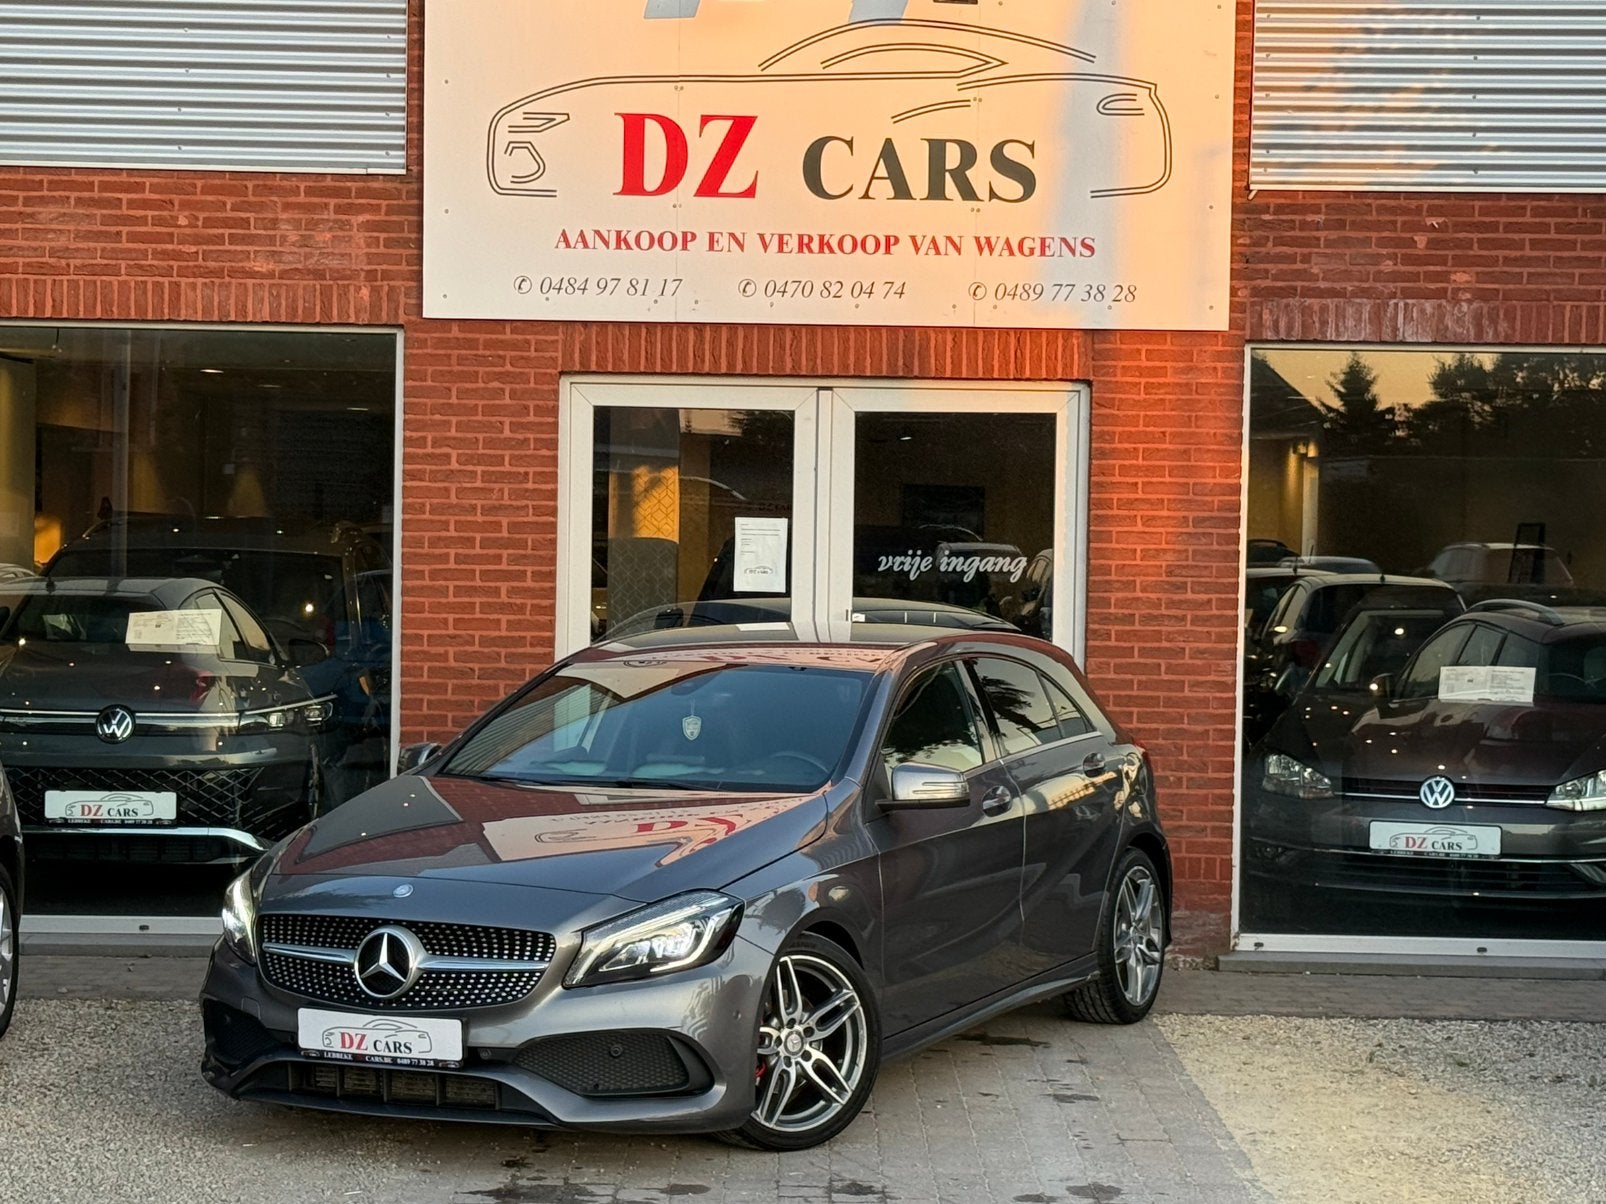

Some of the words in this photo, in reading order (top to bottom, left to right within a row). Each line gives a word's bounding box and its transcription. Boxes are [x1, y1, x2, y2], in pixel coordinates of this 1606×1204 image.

[611, 111, 759, 199] DZ
[801, 134, 1038, 205] CARS
[553, 228, 699, 253] AANKOOP
[706, 230, 747, 254] EN
[755, 232, 901, 256] VERKOOP
[907, 233, 964, 257] VAN
[972, 235, 1097, 259] WAGENS
[538, 276, 590, 296] 0484
[595, 277, 622, 297] 97
[625, 277, 651, 298] 81
[657, 278, 684, 298] 17
[763, 280, 815, 299] 0470
[818, 280, 845, 299] 82
[849, 280, 876, 300] 04
[880, 281, 907, 300] 74
[993, 282, 1045, 302] 0489
[1051, 283, 1077, 302] 77
[1080, 283, 1107, 303] 38
[1111, 284, 1138, 304] 28
[877, 549, 934, 581] vrije
[938, 549, 1028, 583] ingang
[80, 804, 103, 817] DZ
[107, 807, 138, 817] CARS
[1405, 836, 1428, 849] DZ
[1431, 840, 1463, 851] CARS
[340, 1031, 368, 1051] DZ
[373, 1039, 412, 1054] CARS
